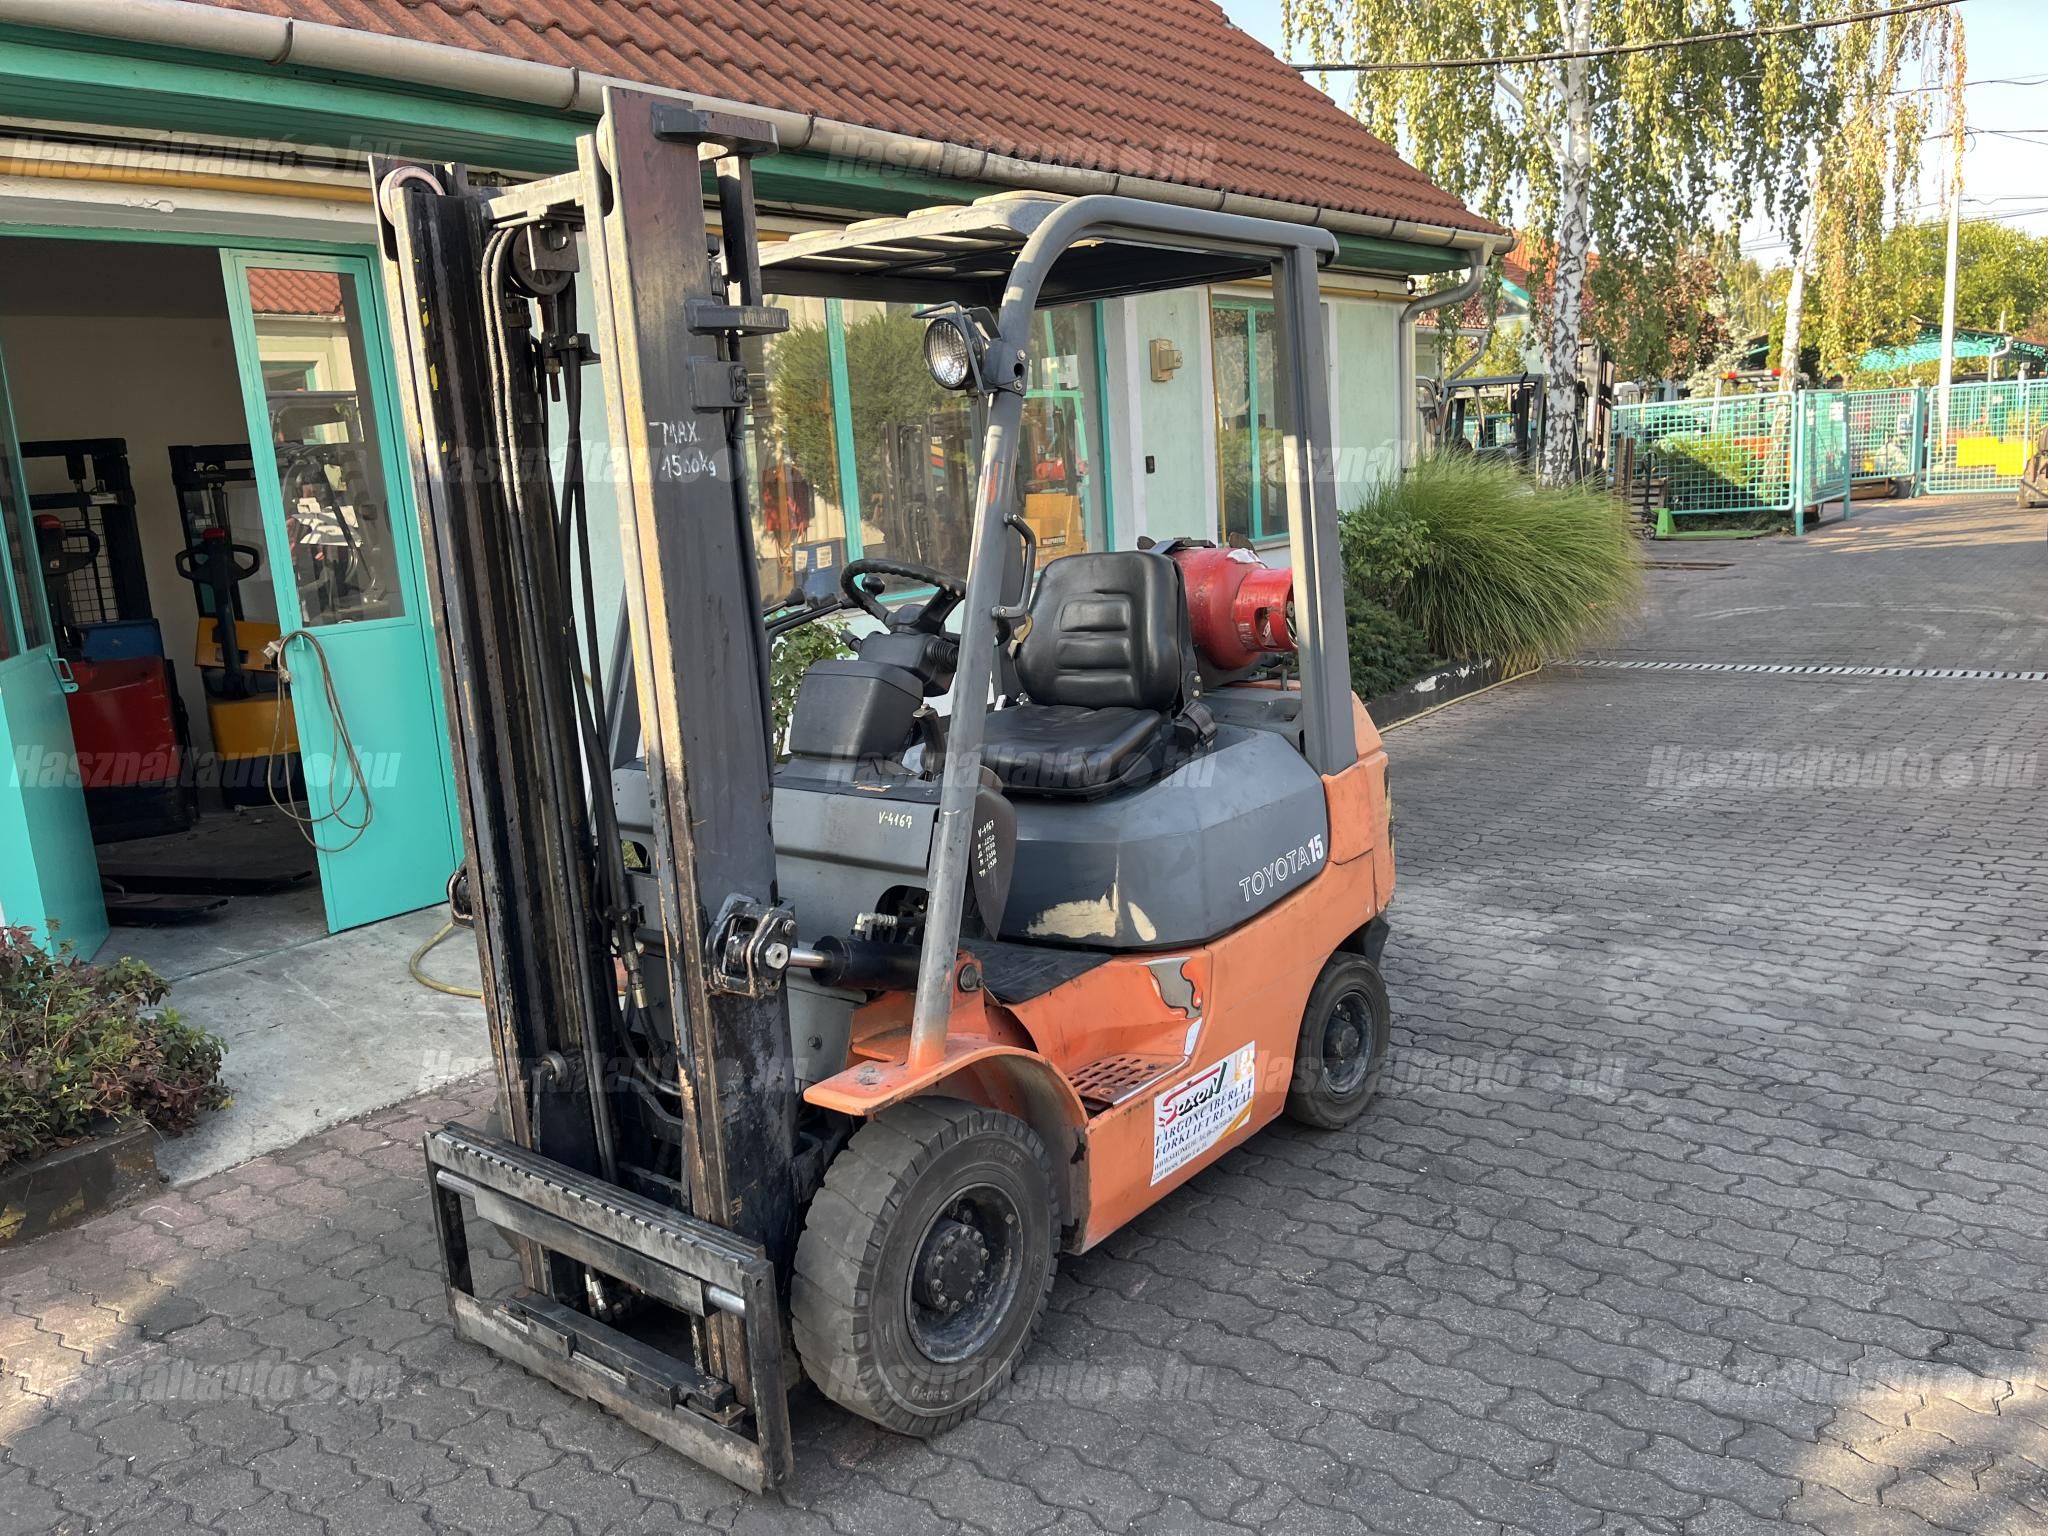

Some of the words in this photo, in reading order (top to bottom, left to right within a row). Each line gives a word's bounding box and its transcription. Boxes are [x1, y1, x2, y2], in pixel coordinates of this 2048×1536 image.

[649, 420, 698, 446] MAX
[878, 811, 913, 829] V-4167
[1238, 846, 1311, 902] TOYOTA
[1307, 833, 1324, 862] 15
